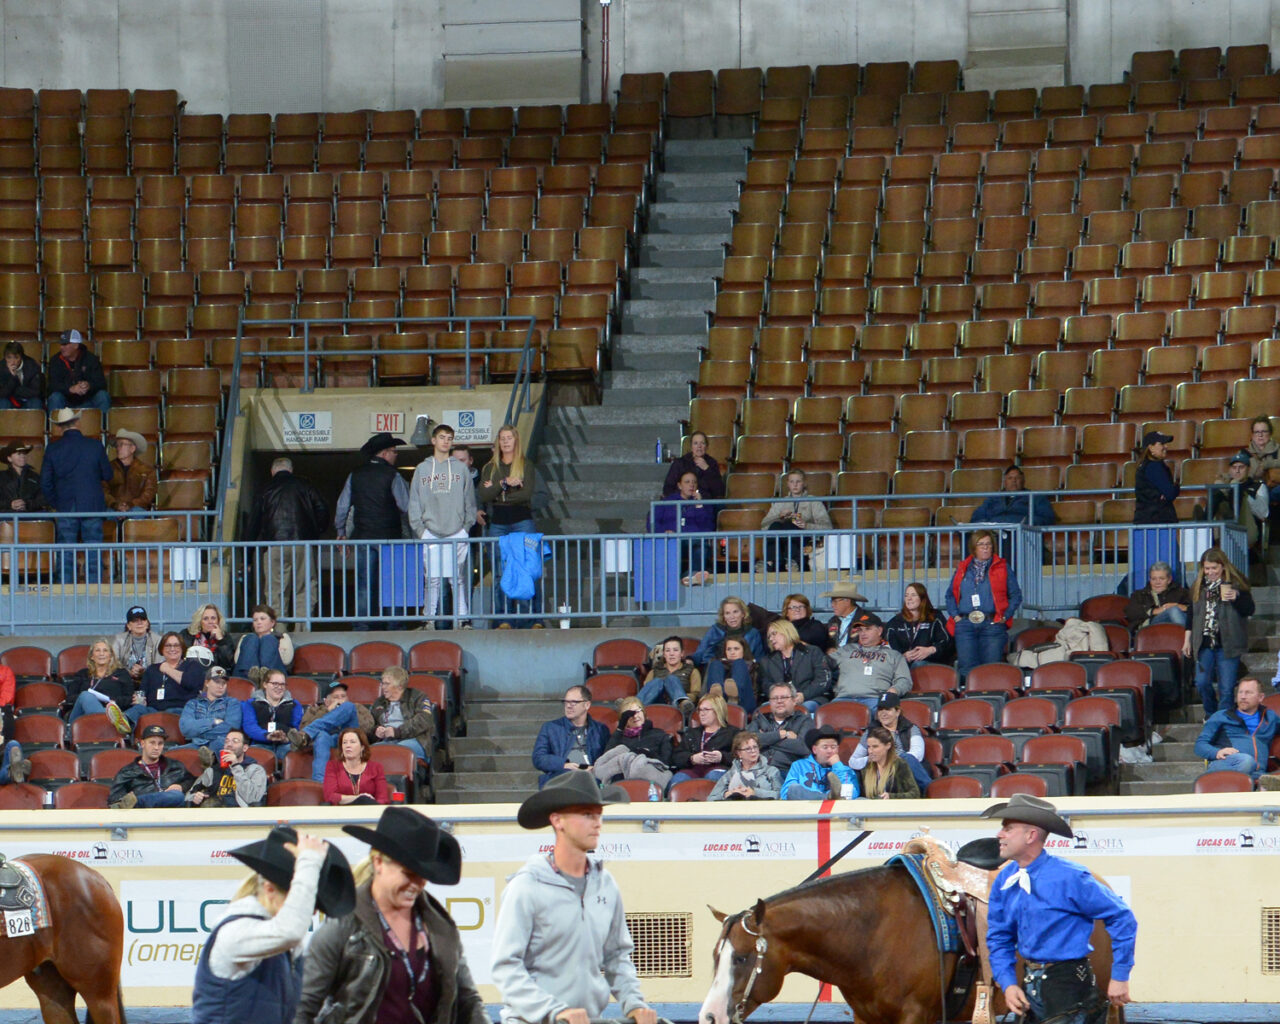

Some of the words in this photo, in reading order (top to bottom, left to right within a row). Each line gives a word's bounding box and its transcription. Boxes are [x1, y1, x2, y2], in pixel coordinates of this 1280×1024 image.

[376, 413, 400, 432] EXIT
[471, 433, 489, 441] RAMP
[763, 842, 796, 852] AQHA
[868, 841, 894, 850] LUCAS
[1091, 839, 1124, 849] AQHA
[1196, 839, 1222, 847] LUCAS
[1223, 838, 1237, 846] OIL
[539, 844, 554, 853] LUC
[598, 844, 631, 855] AQHA
[703, 843, 730, 852] LUCAS
[730, 843, 743, 851] OIL
[77, 850, 90, 858] OIL
[110, 849, 143, 859] AQHA
[8, 916, 31, 935] 826
